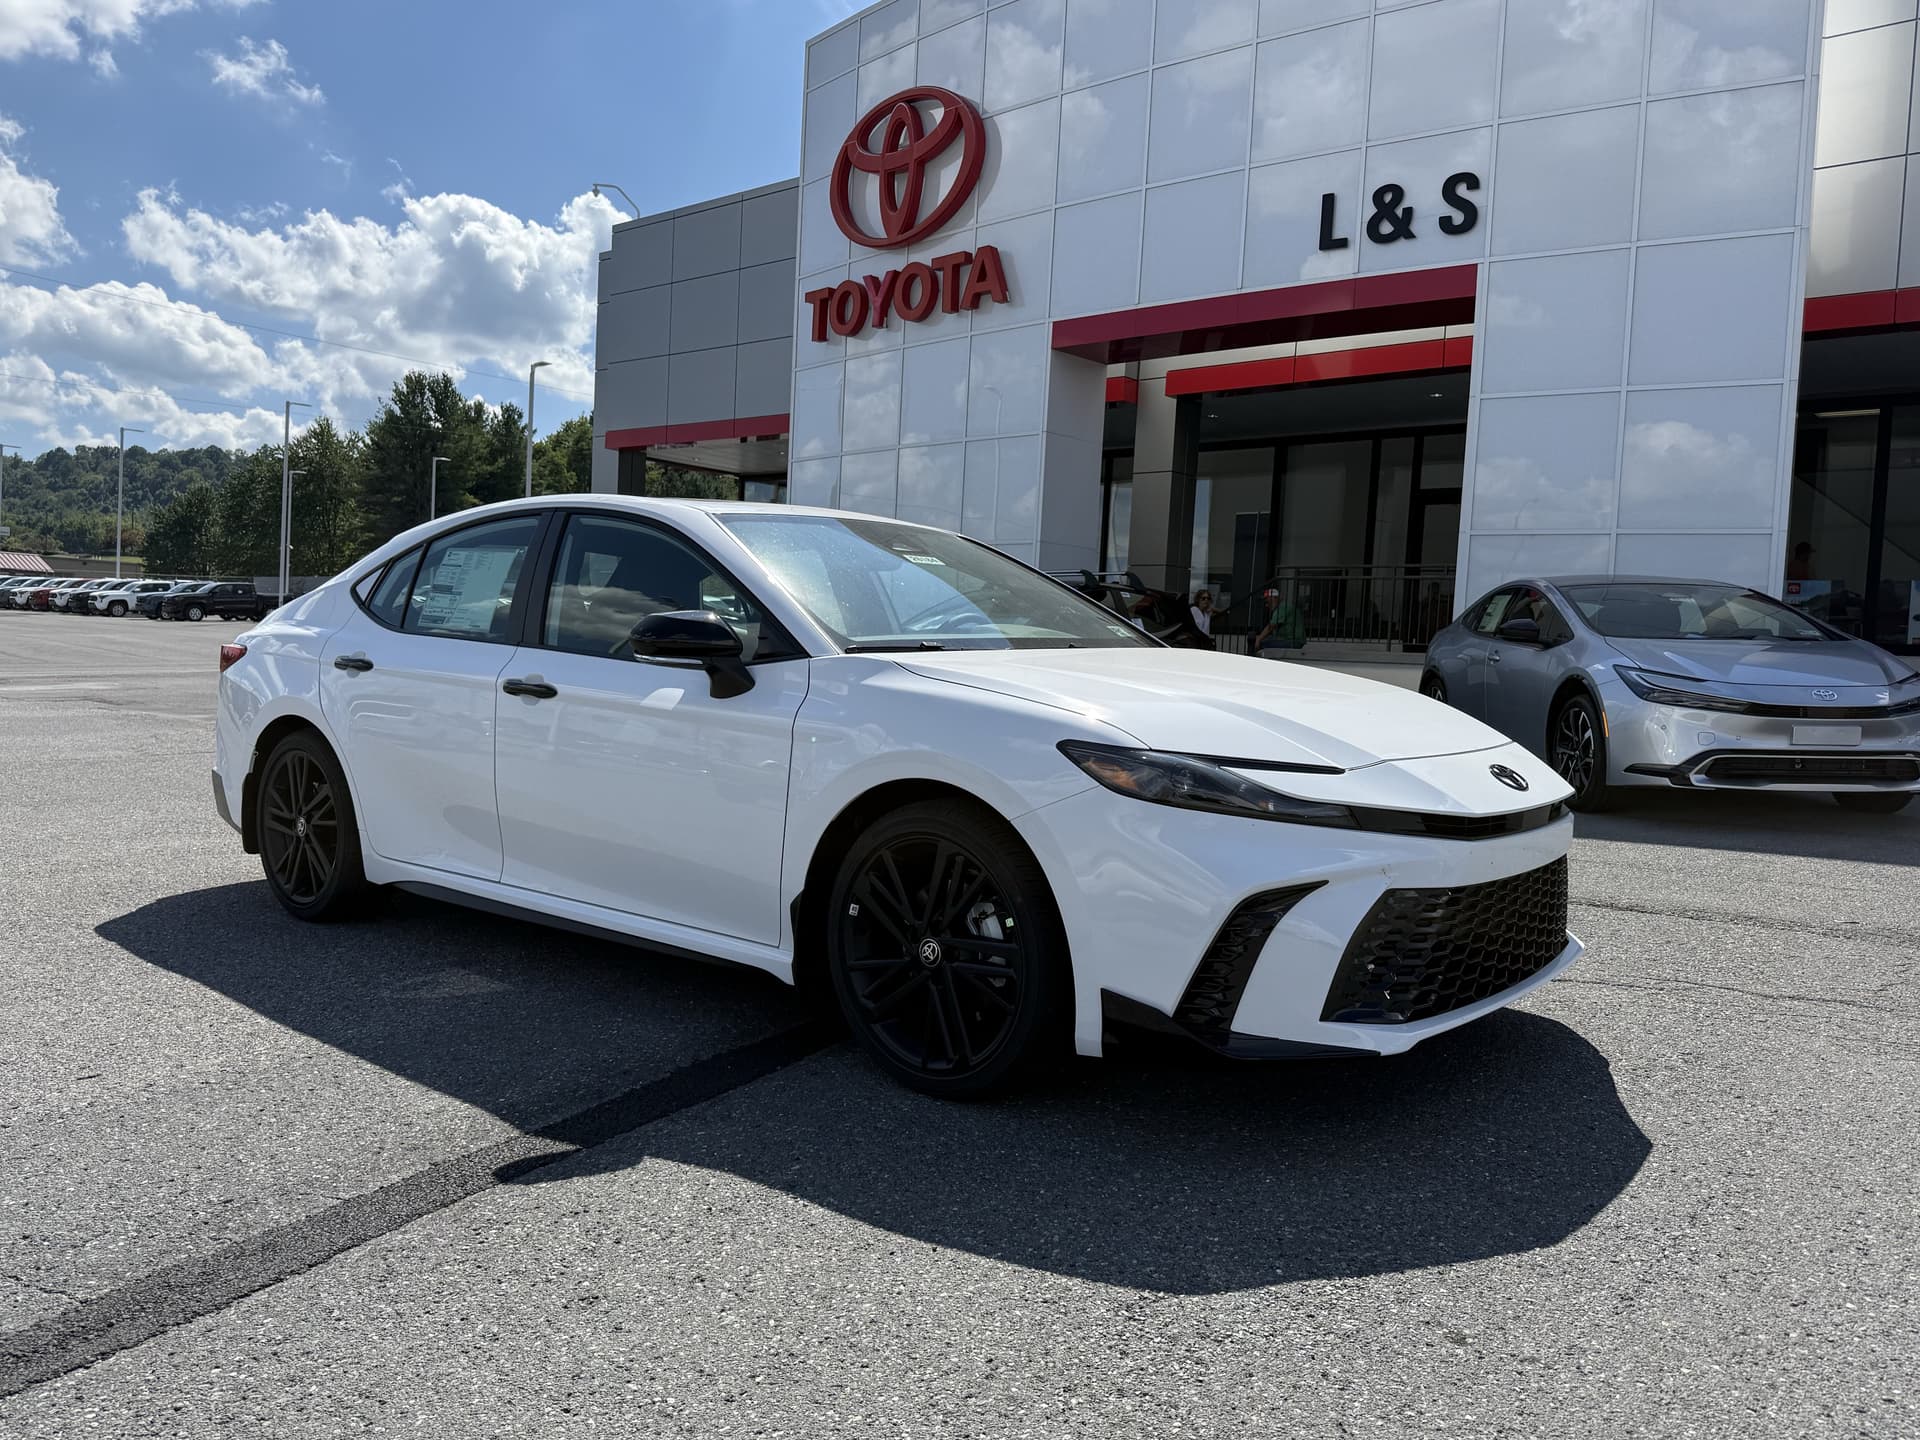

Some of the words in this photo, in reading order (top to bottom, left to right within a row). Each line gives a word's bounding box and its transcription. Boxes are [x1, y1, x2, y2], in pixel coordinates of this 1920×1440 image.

[1319, 193, 1348, 251] L
[1366, 183, 1416, 244] &
[1439, 172, 1480, 235] S
[805, 245, 1009, 342] TOYOTA
